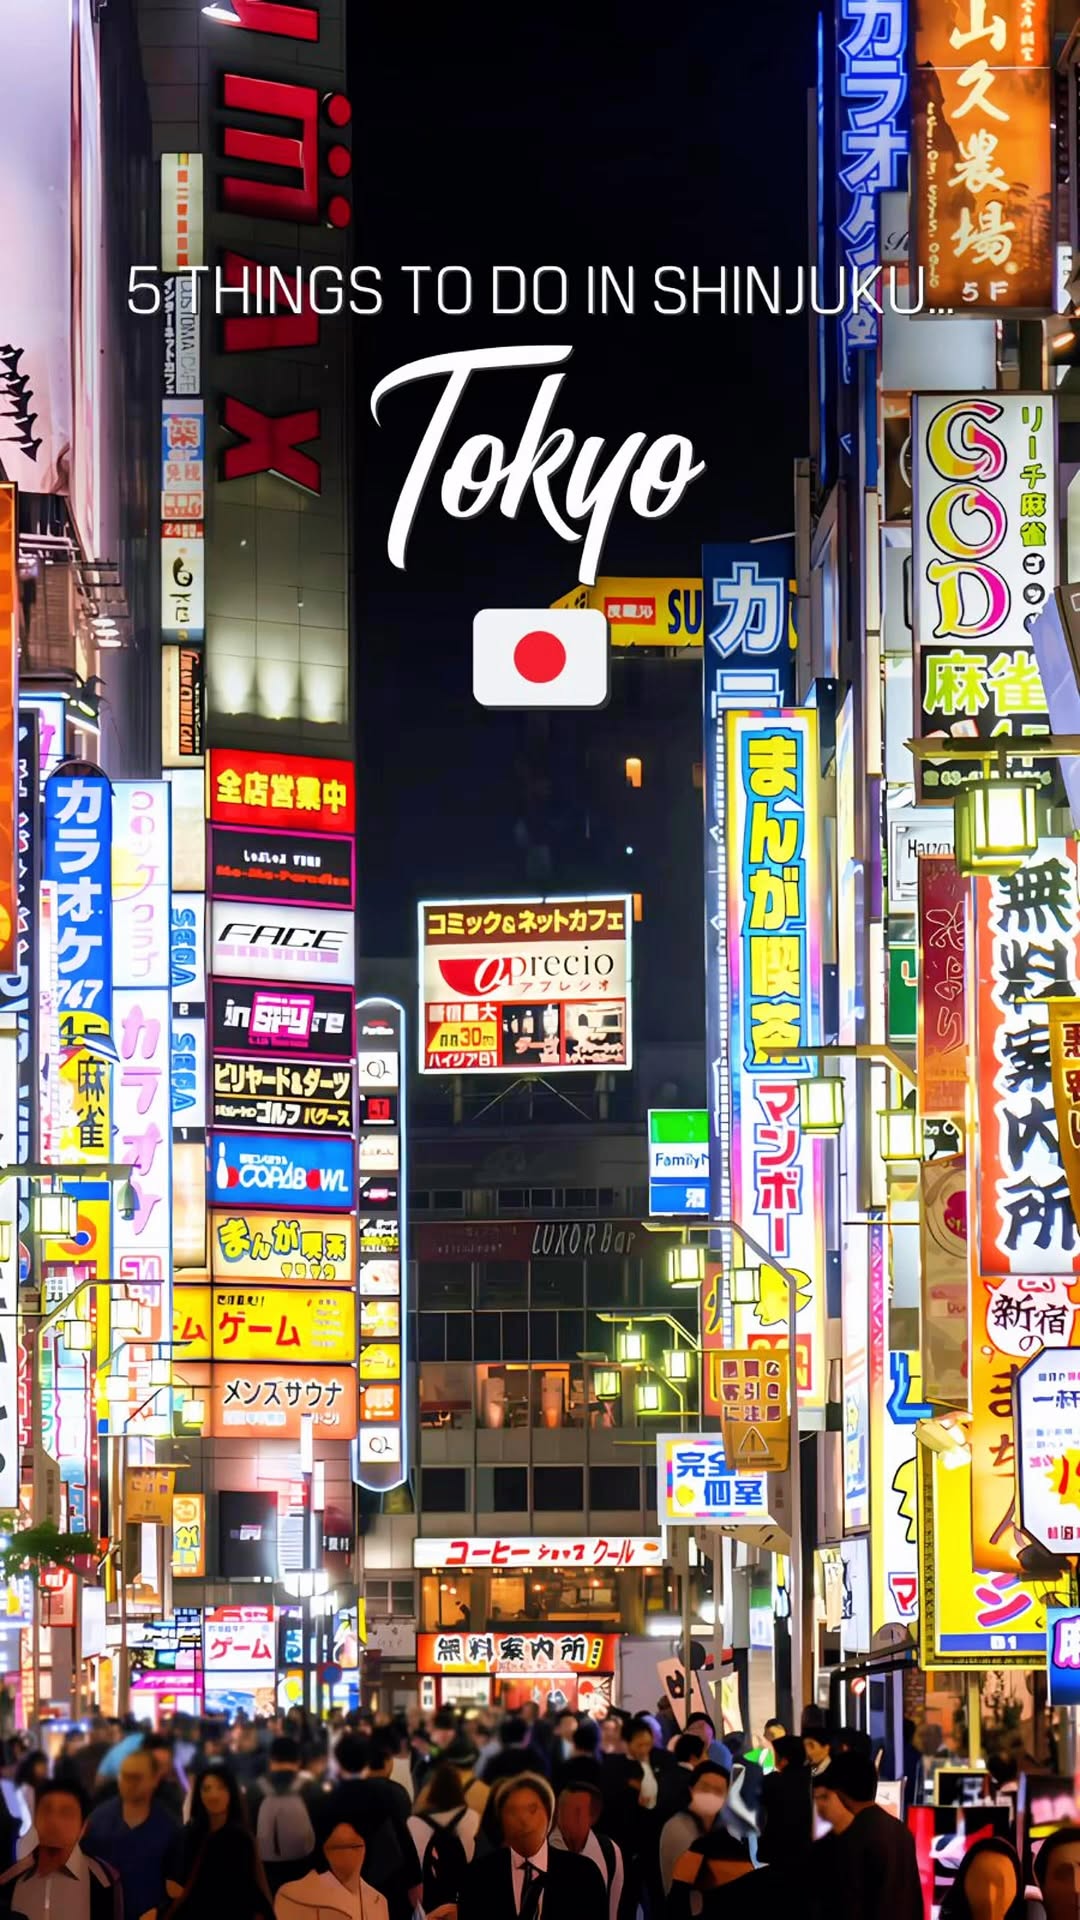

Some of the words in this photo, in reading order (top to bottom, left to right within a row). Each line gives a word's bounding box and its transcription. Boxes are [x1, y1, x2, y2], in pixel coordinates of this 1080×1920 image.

[961, 281, 1009, 302] 5F
[926, 399, 1011, 639] GOD
[923, 649, 1050, 717] 麻雀
[216, 768, 347, 814] 全店営業中
[53, 779, 103, 974] カラオケ
[218, 922, 349, 951] FACE
[428, 908, 624, 935] コミック&ネットカフェ
[474, 945, 615, 994] aprecio
[759, 1085, 796, 1252] マンボー
[532, 1224, 596, 1255] LUXOR
[600, 1223, 636, 1254] Bar
[218, 1310, 301, 1347] ゲーム
[991, 1294, 1069, 1338] 新宿
[223, 1379, 343, 1408] メンズサウナ
[209, 1637, 272, 1661] ゲーム
[435, 1635, 588, 1664] 無料案内所
